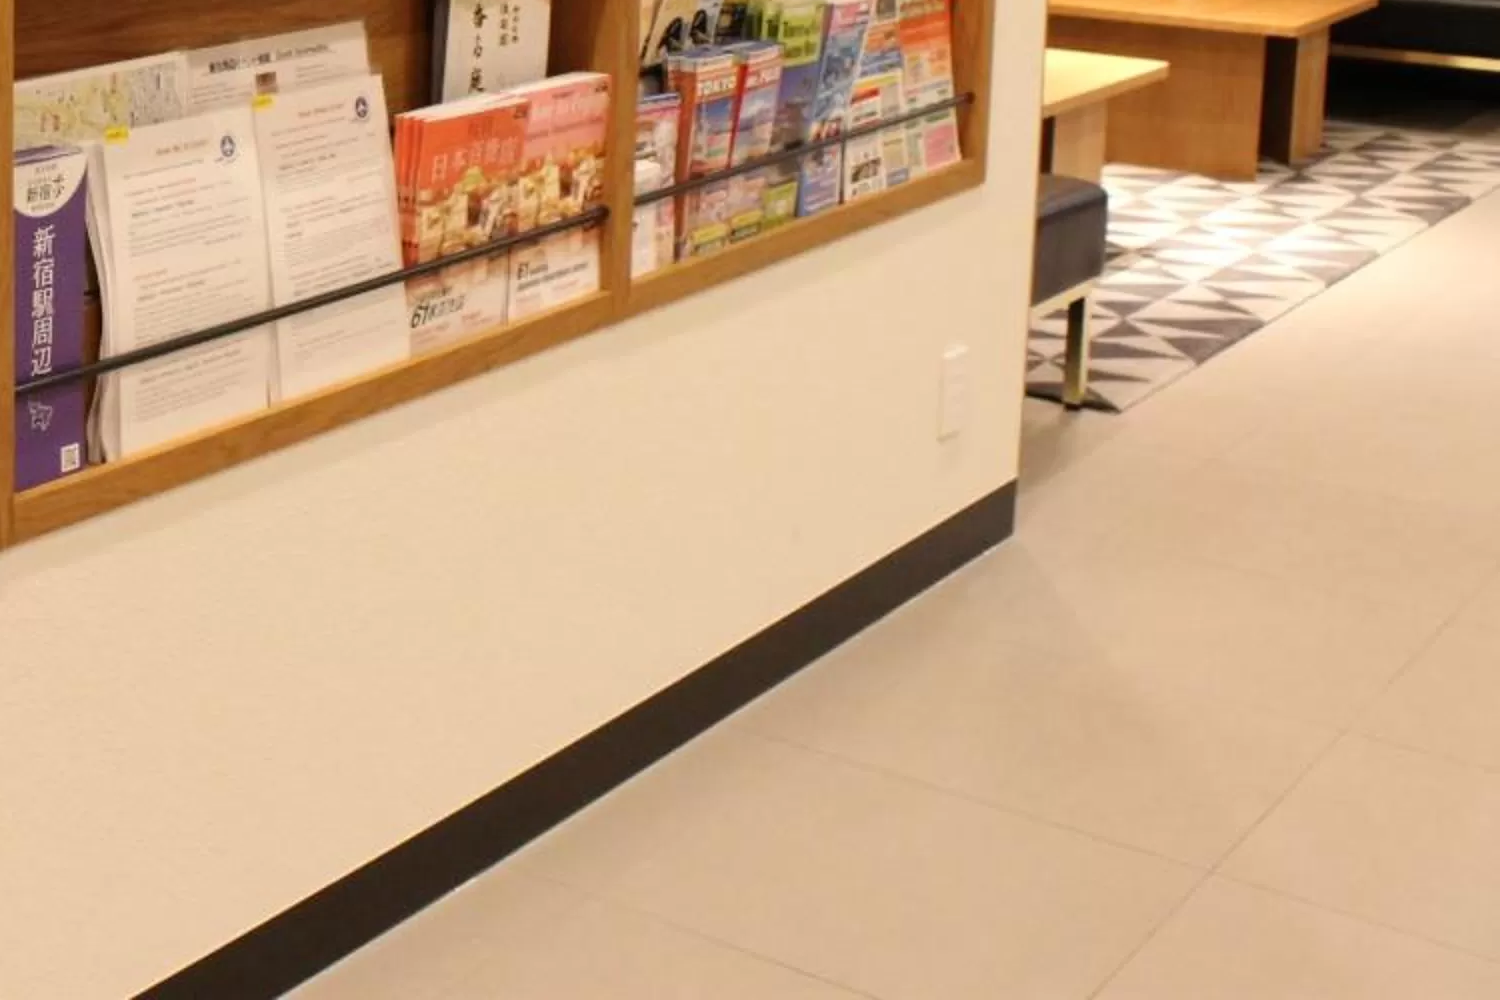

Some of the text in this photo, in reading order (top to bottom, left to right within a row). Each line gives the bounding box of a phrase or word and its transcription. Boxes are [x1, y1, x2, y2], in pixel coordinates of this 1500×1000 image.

[30, 223, 57, 377] 新宿駅周辺
